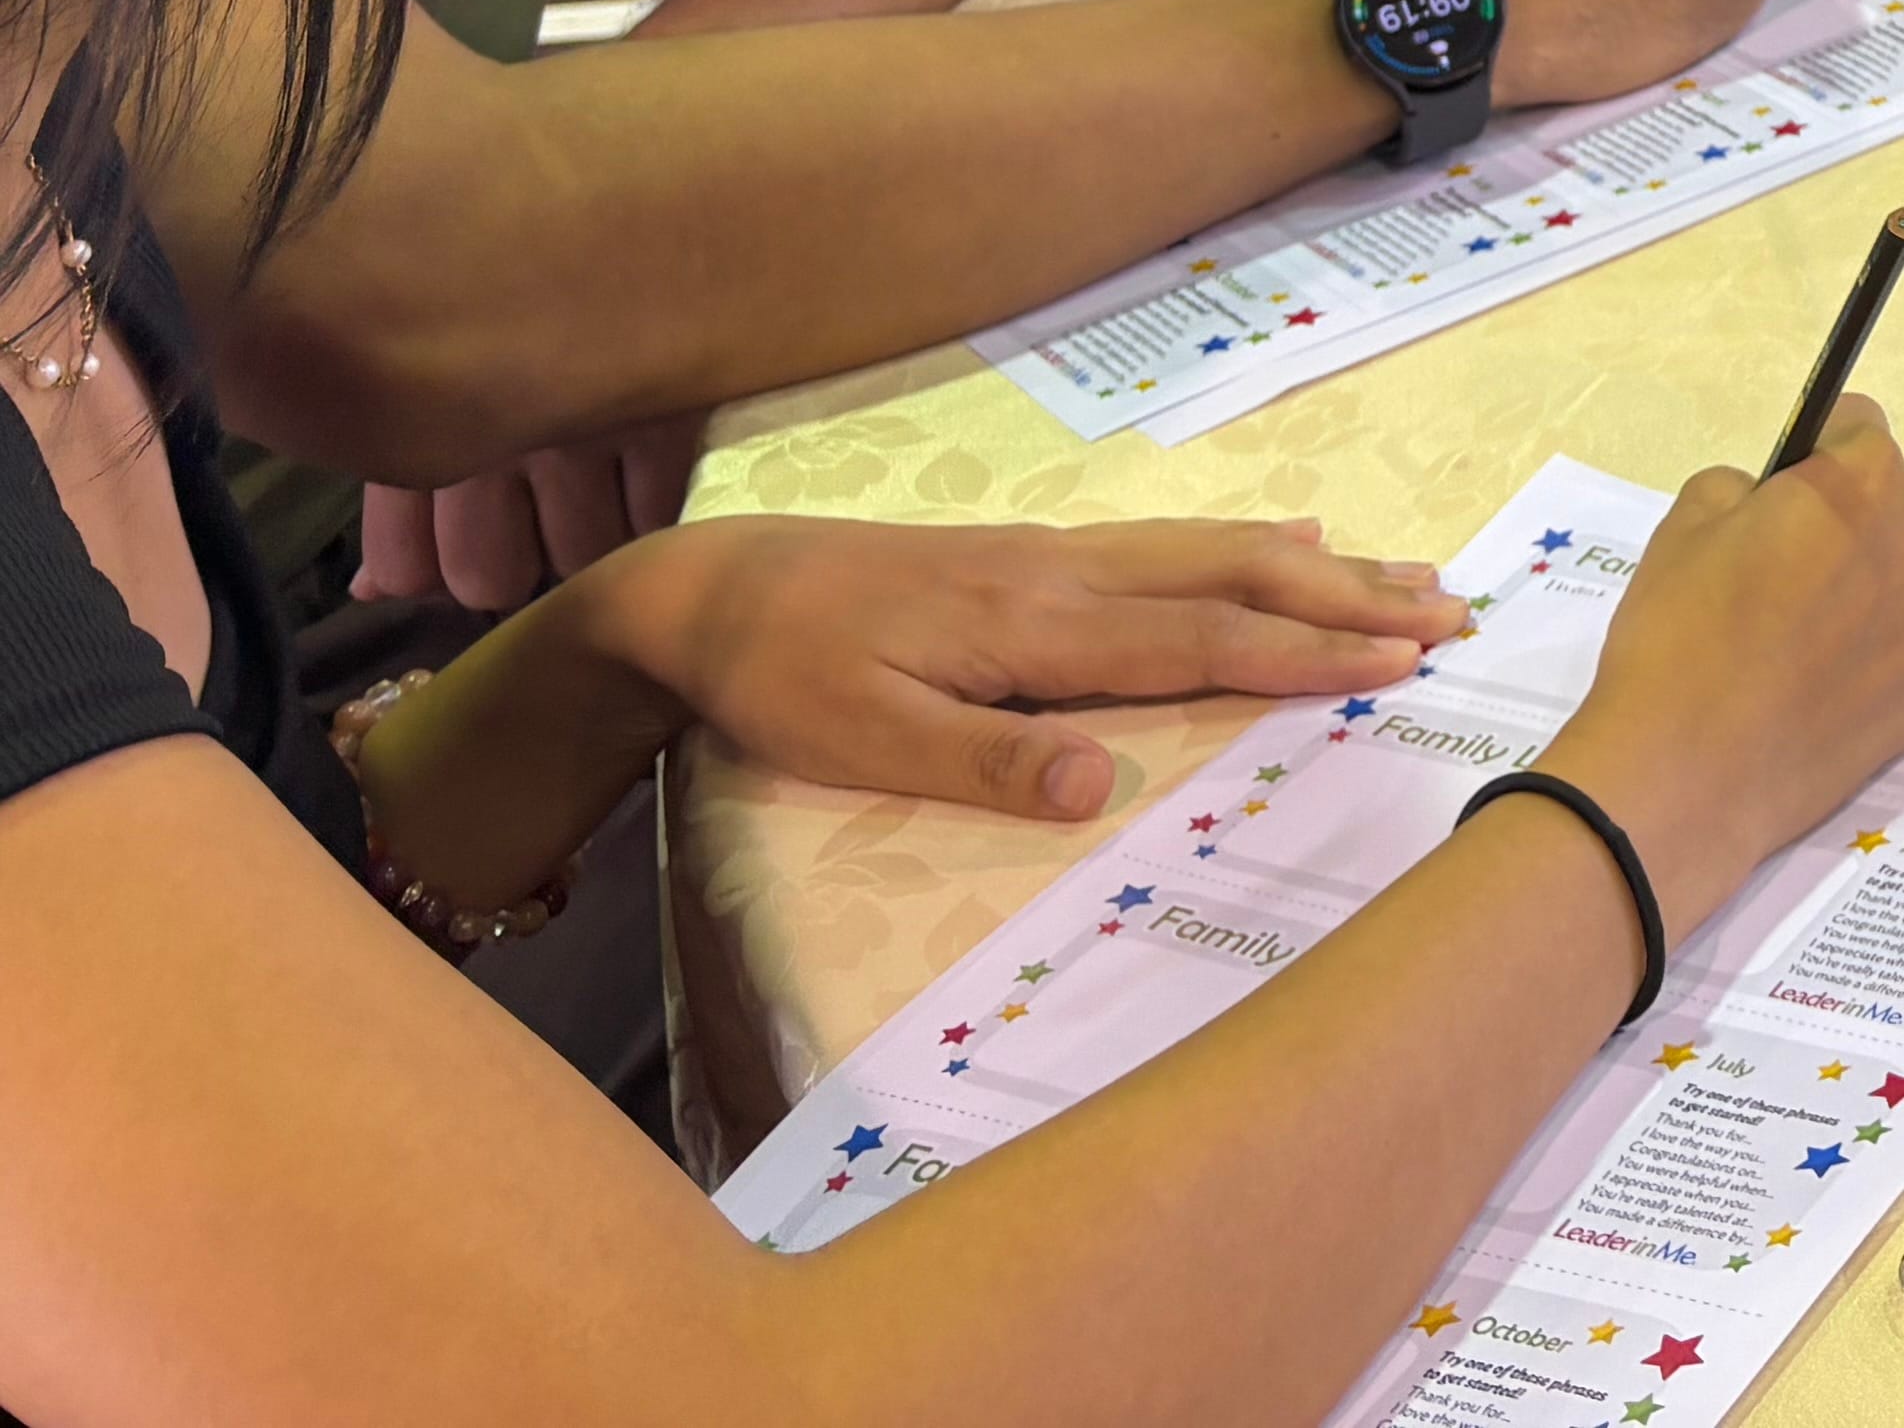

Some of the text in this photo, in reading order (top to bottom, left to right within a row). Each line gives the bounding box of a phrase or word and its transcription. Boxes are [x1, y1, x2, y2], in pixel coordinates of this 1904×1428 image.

[1373, 715, 1511, 771] Family
[1864, 876, 1881, 886] to
[1877, 880, 1903, 891] get
[1877, 863, 1899, 877] Try
[1855, 888, 1893, 906] Thank
[1849, 902, 1877, 917] love
[1877, 909, 1900, 923] the
[1148, 905, 1297, 967] Family
[1822, 925, 1847, 940] You
[1848, 934, 1880, 947] were
[1815, 941, 1884, 963] appreciate
[1769, 981, 1901, 1024] LeaderinMe
[1706, 1053, 1755, 1078] July
[1667, 1096, 1685, 1108] to
[1680, 1102, 1709, 1114] get
[1682, 1082, 1840, 1126] Try one of these phrases
[1655, 1111, 1696, 1131] Thank
[1694, 1124, 1724, 1138] you
[1628, 1140, 1735, 1174] Congratulations
[1647, 1127, 1678, 1144] love
[1678, 1136, 1703, 1150] the
[1703, 1143, 1732, 1158] way
[1616, 1153, 1644, 1171] You
[1645, 1164, 1679, 1179] were
[1679, 1169, 1731, 1189] helpful
[1609, 1174, 1682, 1197] appreciate
[1683, 1189, 1721, 1204] when
[1577, 1197, 1604, 1214] You
[1604, 1207, 1645, 1223] made
[1656, 1217, 1727, 1240] difference
[1554, 1219, 1695, 1265] LeaderinMe
[1471, 1316, 1571, 1352] October
[1421, 1367, 1441, 1380] to
[1435, 1373, 1467, 1386] get
[1437, 1349, 1608, 1401] Try one of these phrases
[1402, 1383, 1451, 1406] Thank
[1449, 1400, 1481, 1414] you
[1395, 1402, 1430, 1422] love
[1430, 1412, 1457, 1428] the
